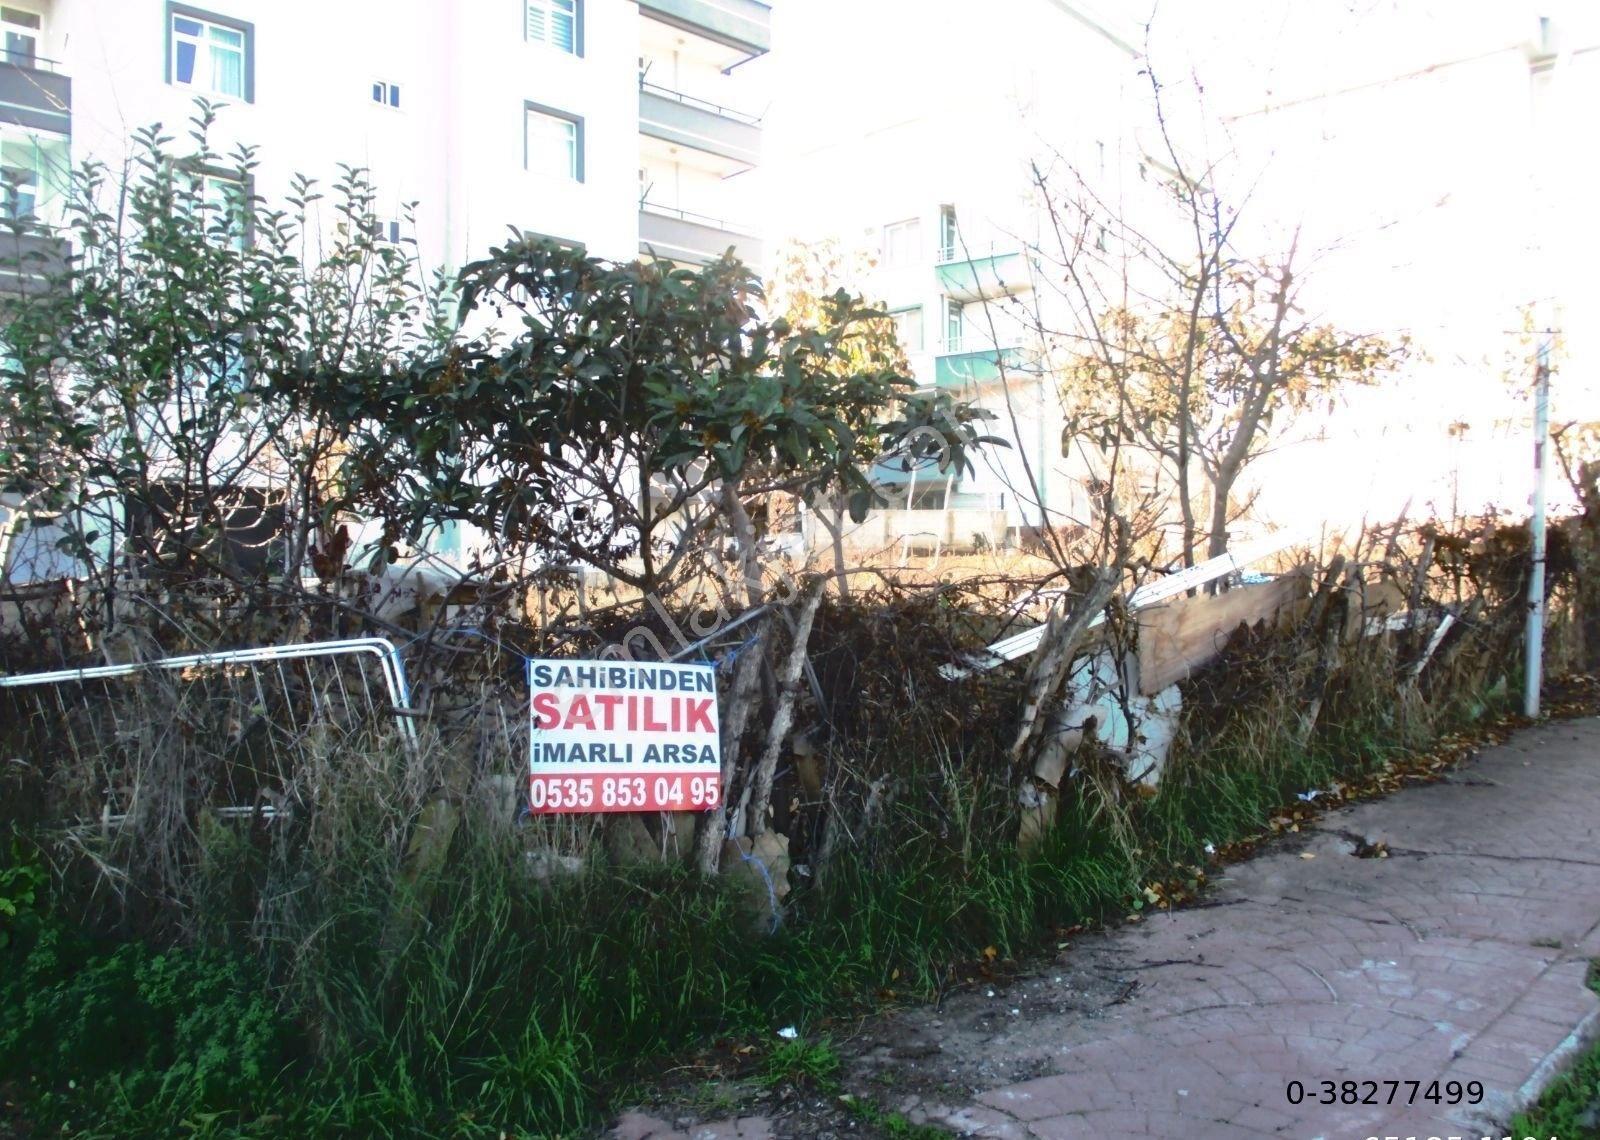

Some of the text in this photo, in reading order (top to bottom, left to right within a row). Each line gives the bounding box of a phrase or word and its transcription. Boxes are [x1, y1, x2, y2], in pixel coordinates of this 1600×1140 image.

[533, 693, 716, 733] SATILIK
[643, 743, 717, 764] ARSA
[531, 776, 718, 808] 0535 853 04 95
